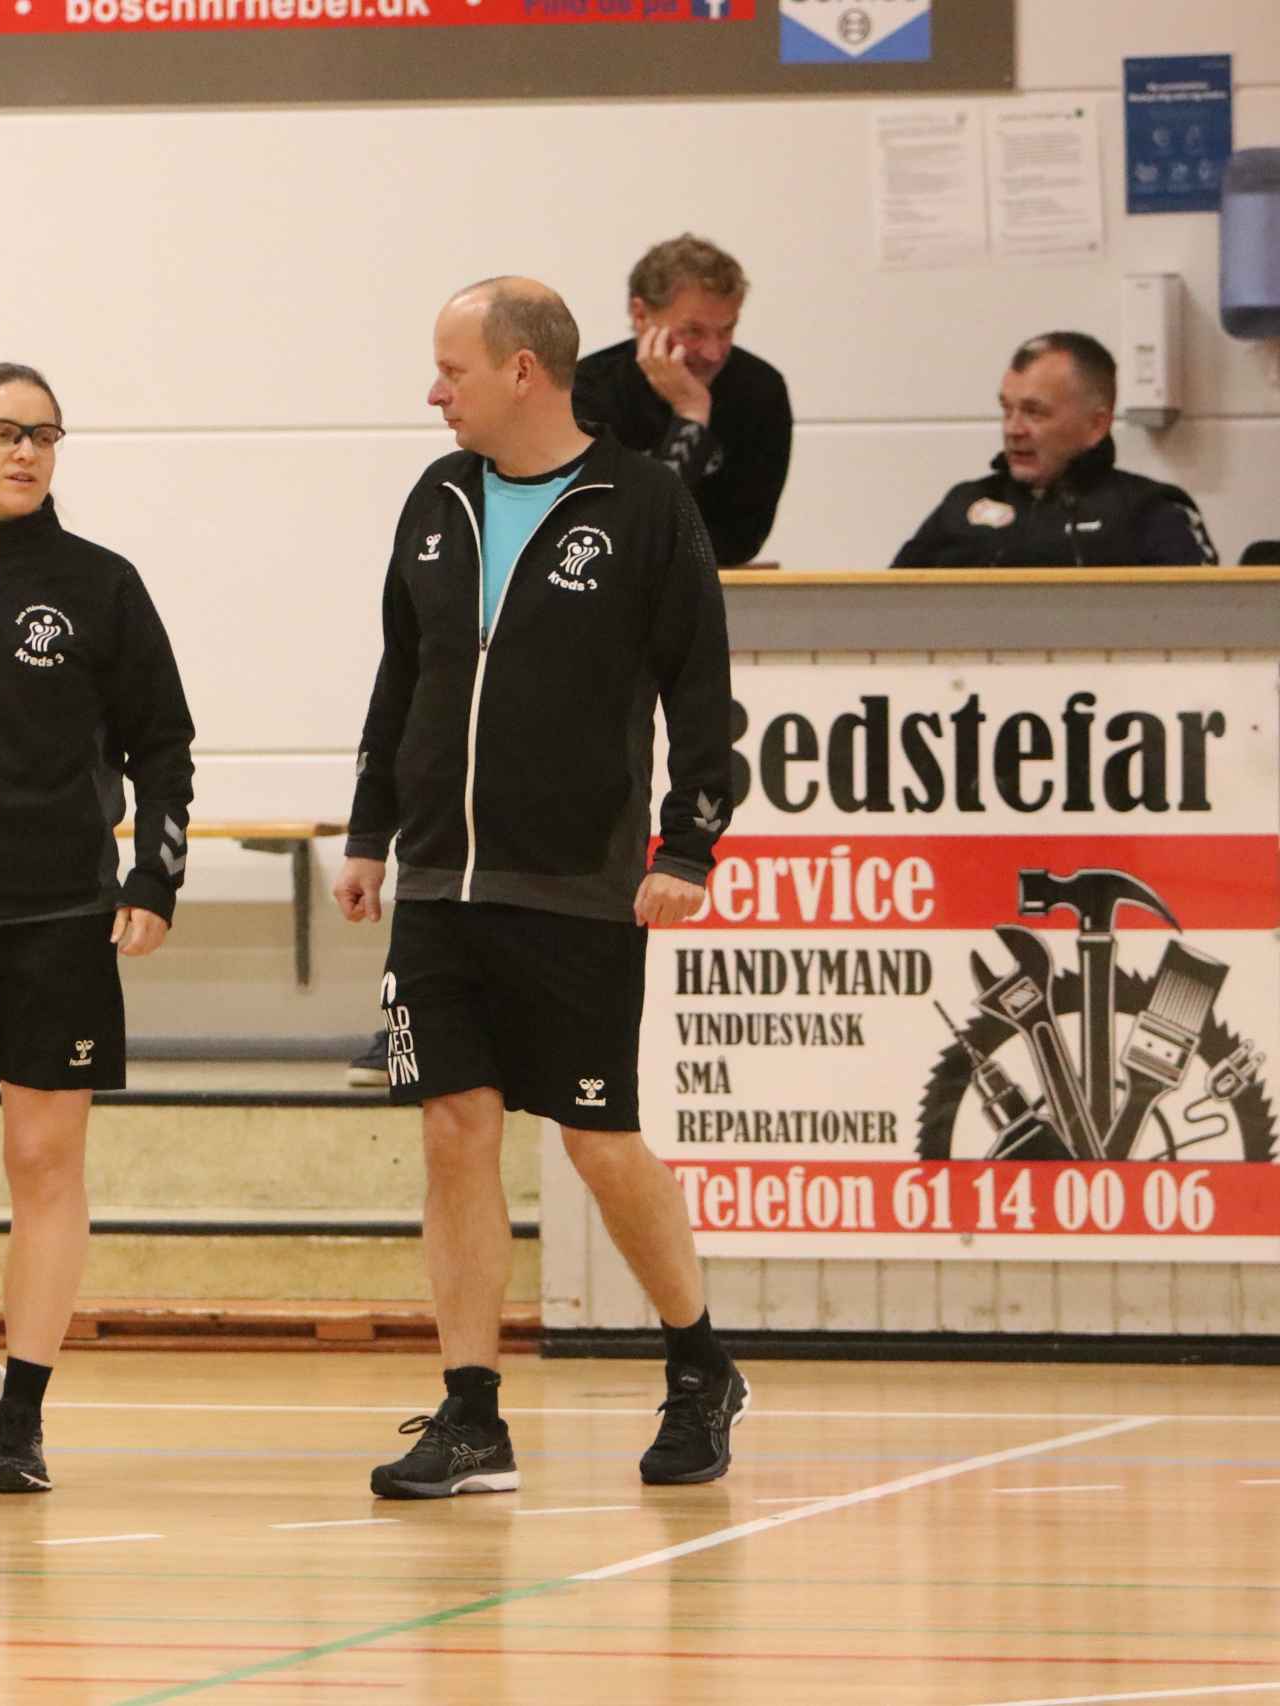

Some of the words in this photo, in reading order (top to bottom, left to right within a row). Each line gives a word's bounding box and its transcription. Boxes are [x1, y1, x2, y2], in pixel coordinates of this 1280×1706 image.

[587, 578, 598, 590] 3
[683, 844, 935, 923] ervice
[674, 948, 933, 997] HANDYMAND
[383, 1005, 411, 1032] ILD
[674, 1012, 865, 1047] VINDUESVASK
[388, 1051, 420, 1087] VIN
[674, 1055, 732, 1095] SMÅ
[676, 1109, 898, 1144] REPARATIONER
[676, 1165, 876, 1230] Telefon
[892, 1167, 953, 1231] 61
[972, 1168, 1036, 1231] 14
[1053, 1168, 1126, 1231] 00
[1143, 1169, 1216, 1232] 06
